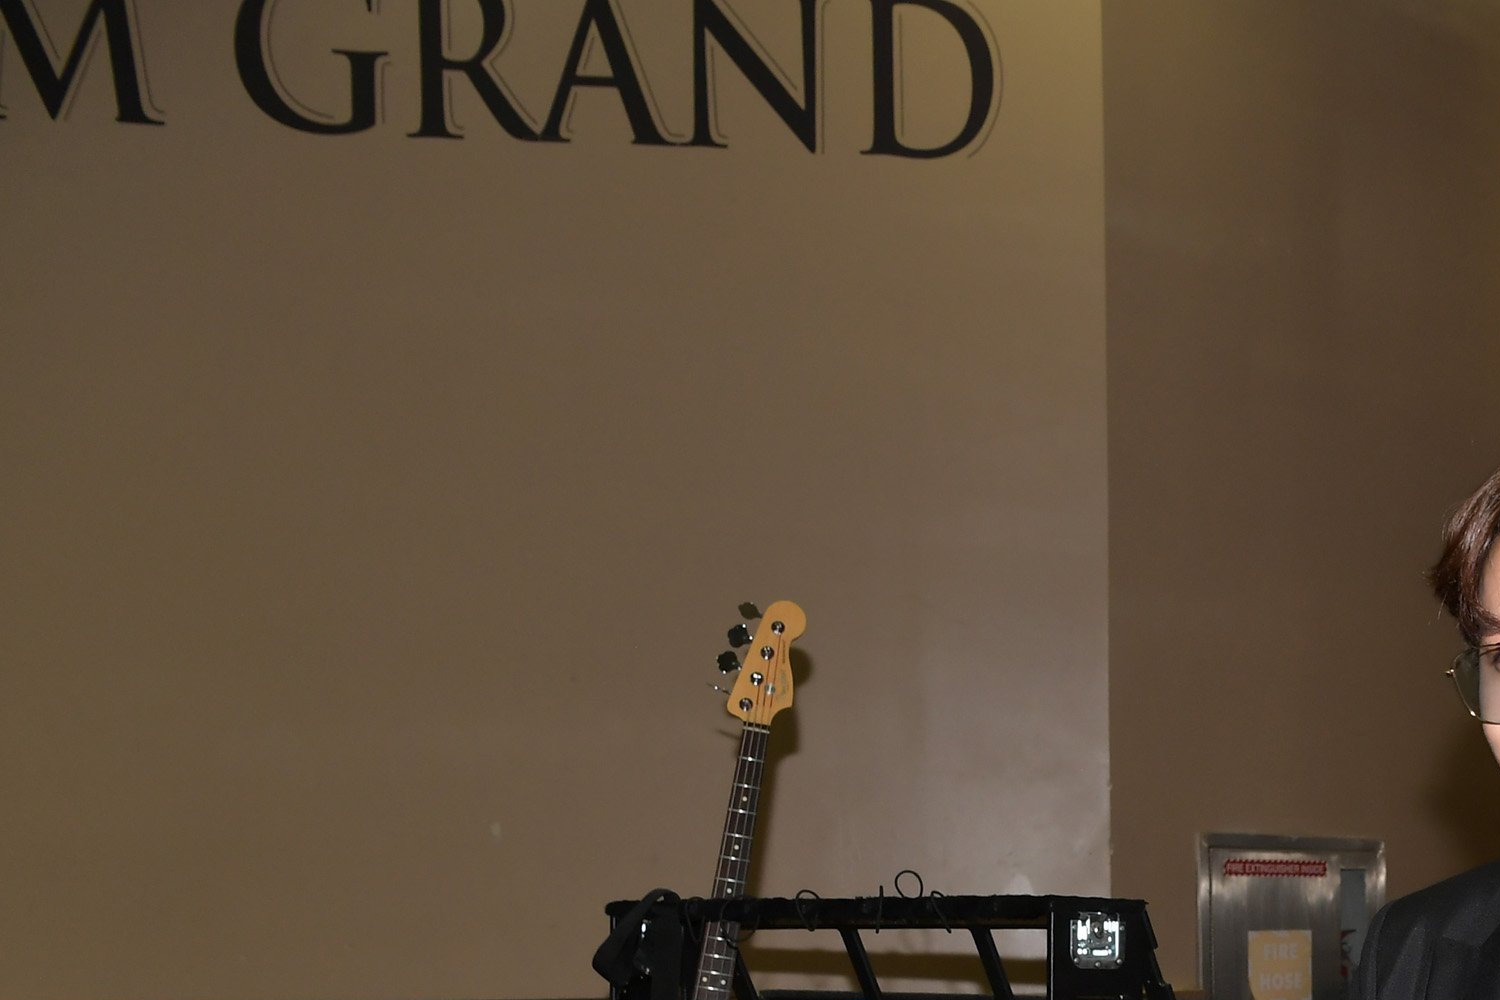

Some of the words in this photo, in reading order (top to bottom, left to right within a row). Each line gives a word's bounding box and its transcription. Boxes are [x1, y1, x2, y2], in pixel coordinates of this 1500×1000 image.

[233, 0, 1000, 159] GRAND
[1262, 944, 1298, 960] FIRE
[1259, 973, 1302, 991] HOSE
